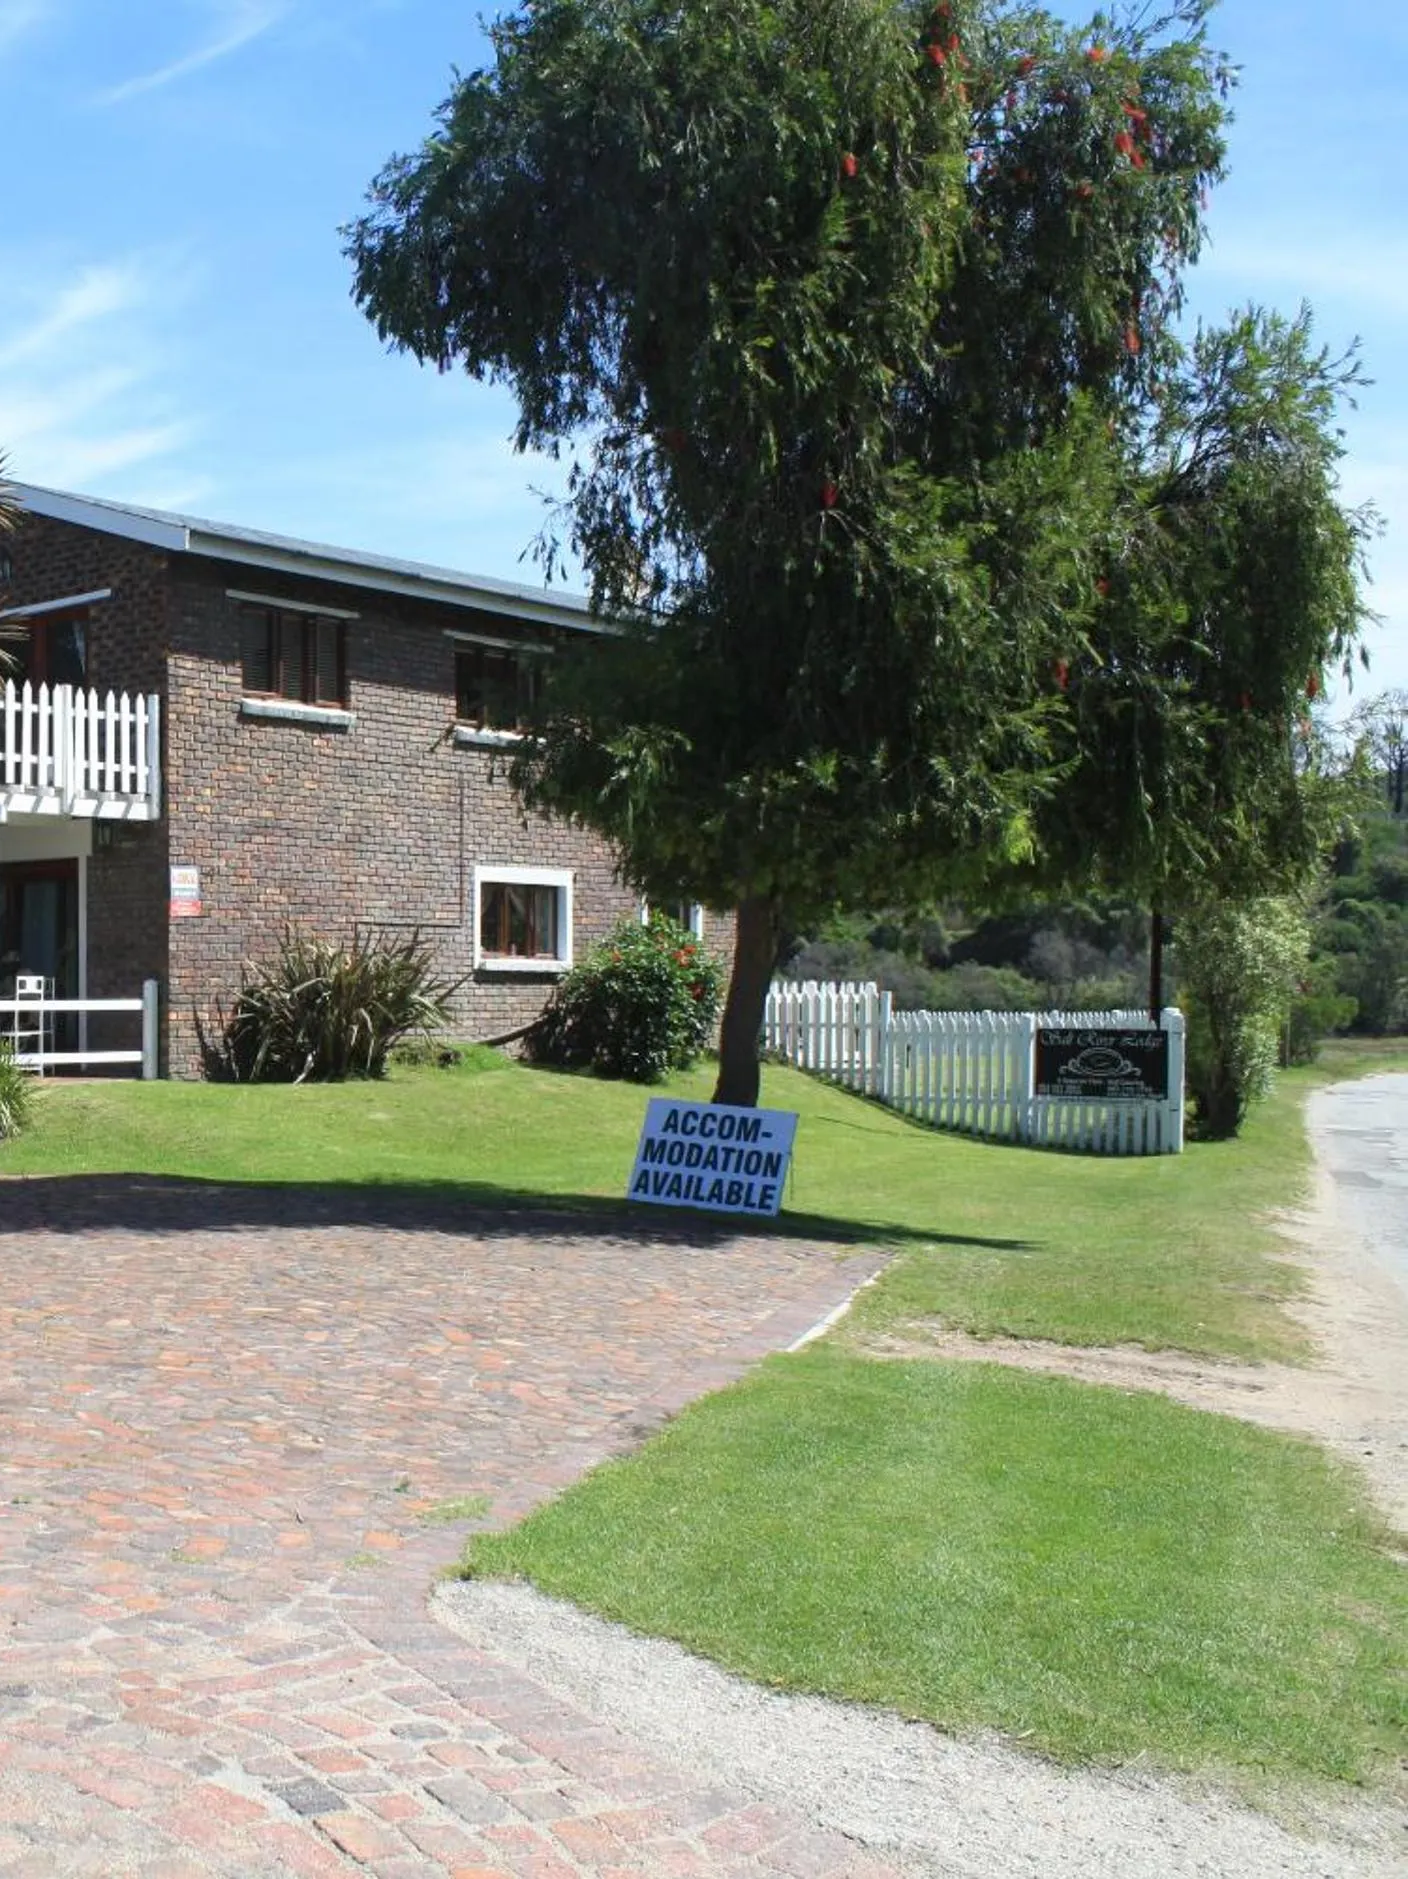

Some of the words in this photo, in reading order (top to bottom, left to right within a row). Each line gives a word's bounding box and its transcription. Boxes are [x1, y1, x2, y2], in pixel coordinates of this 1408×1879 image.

[662, 1108, 774, 1144] ACCOM-
[642, 1137, 783, 1178] MODATION
[632, 1169, 778, 1211] AVAILABLE
